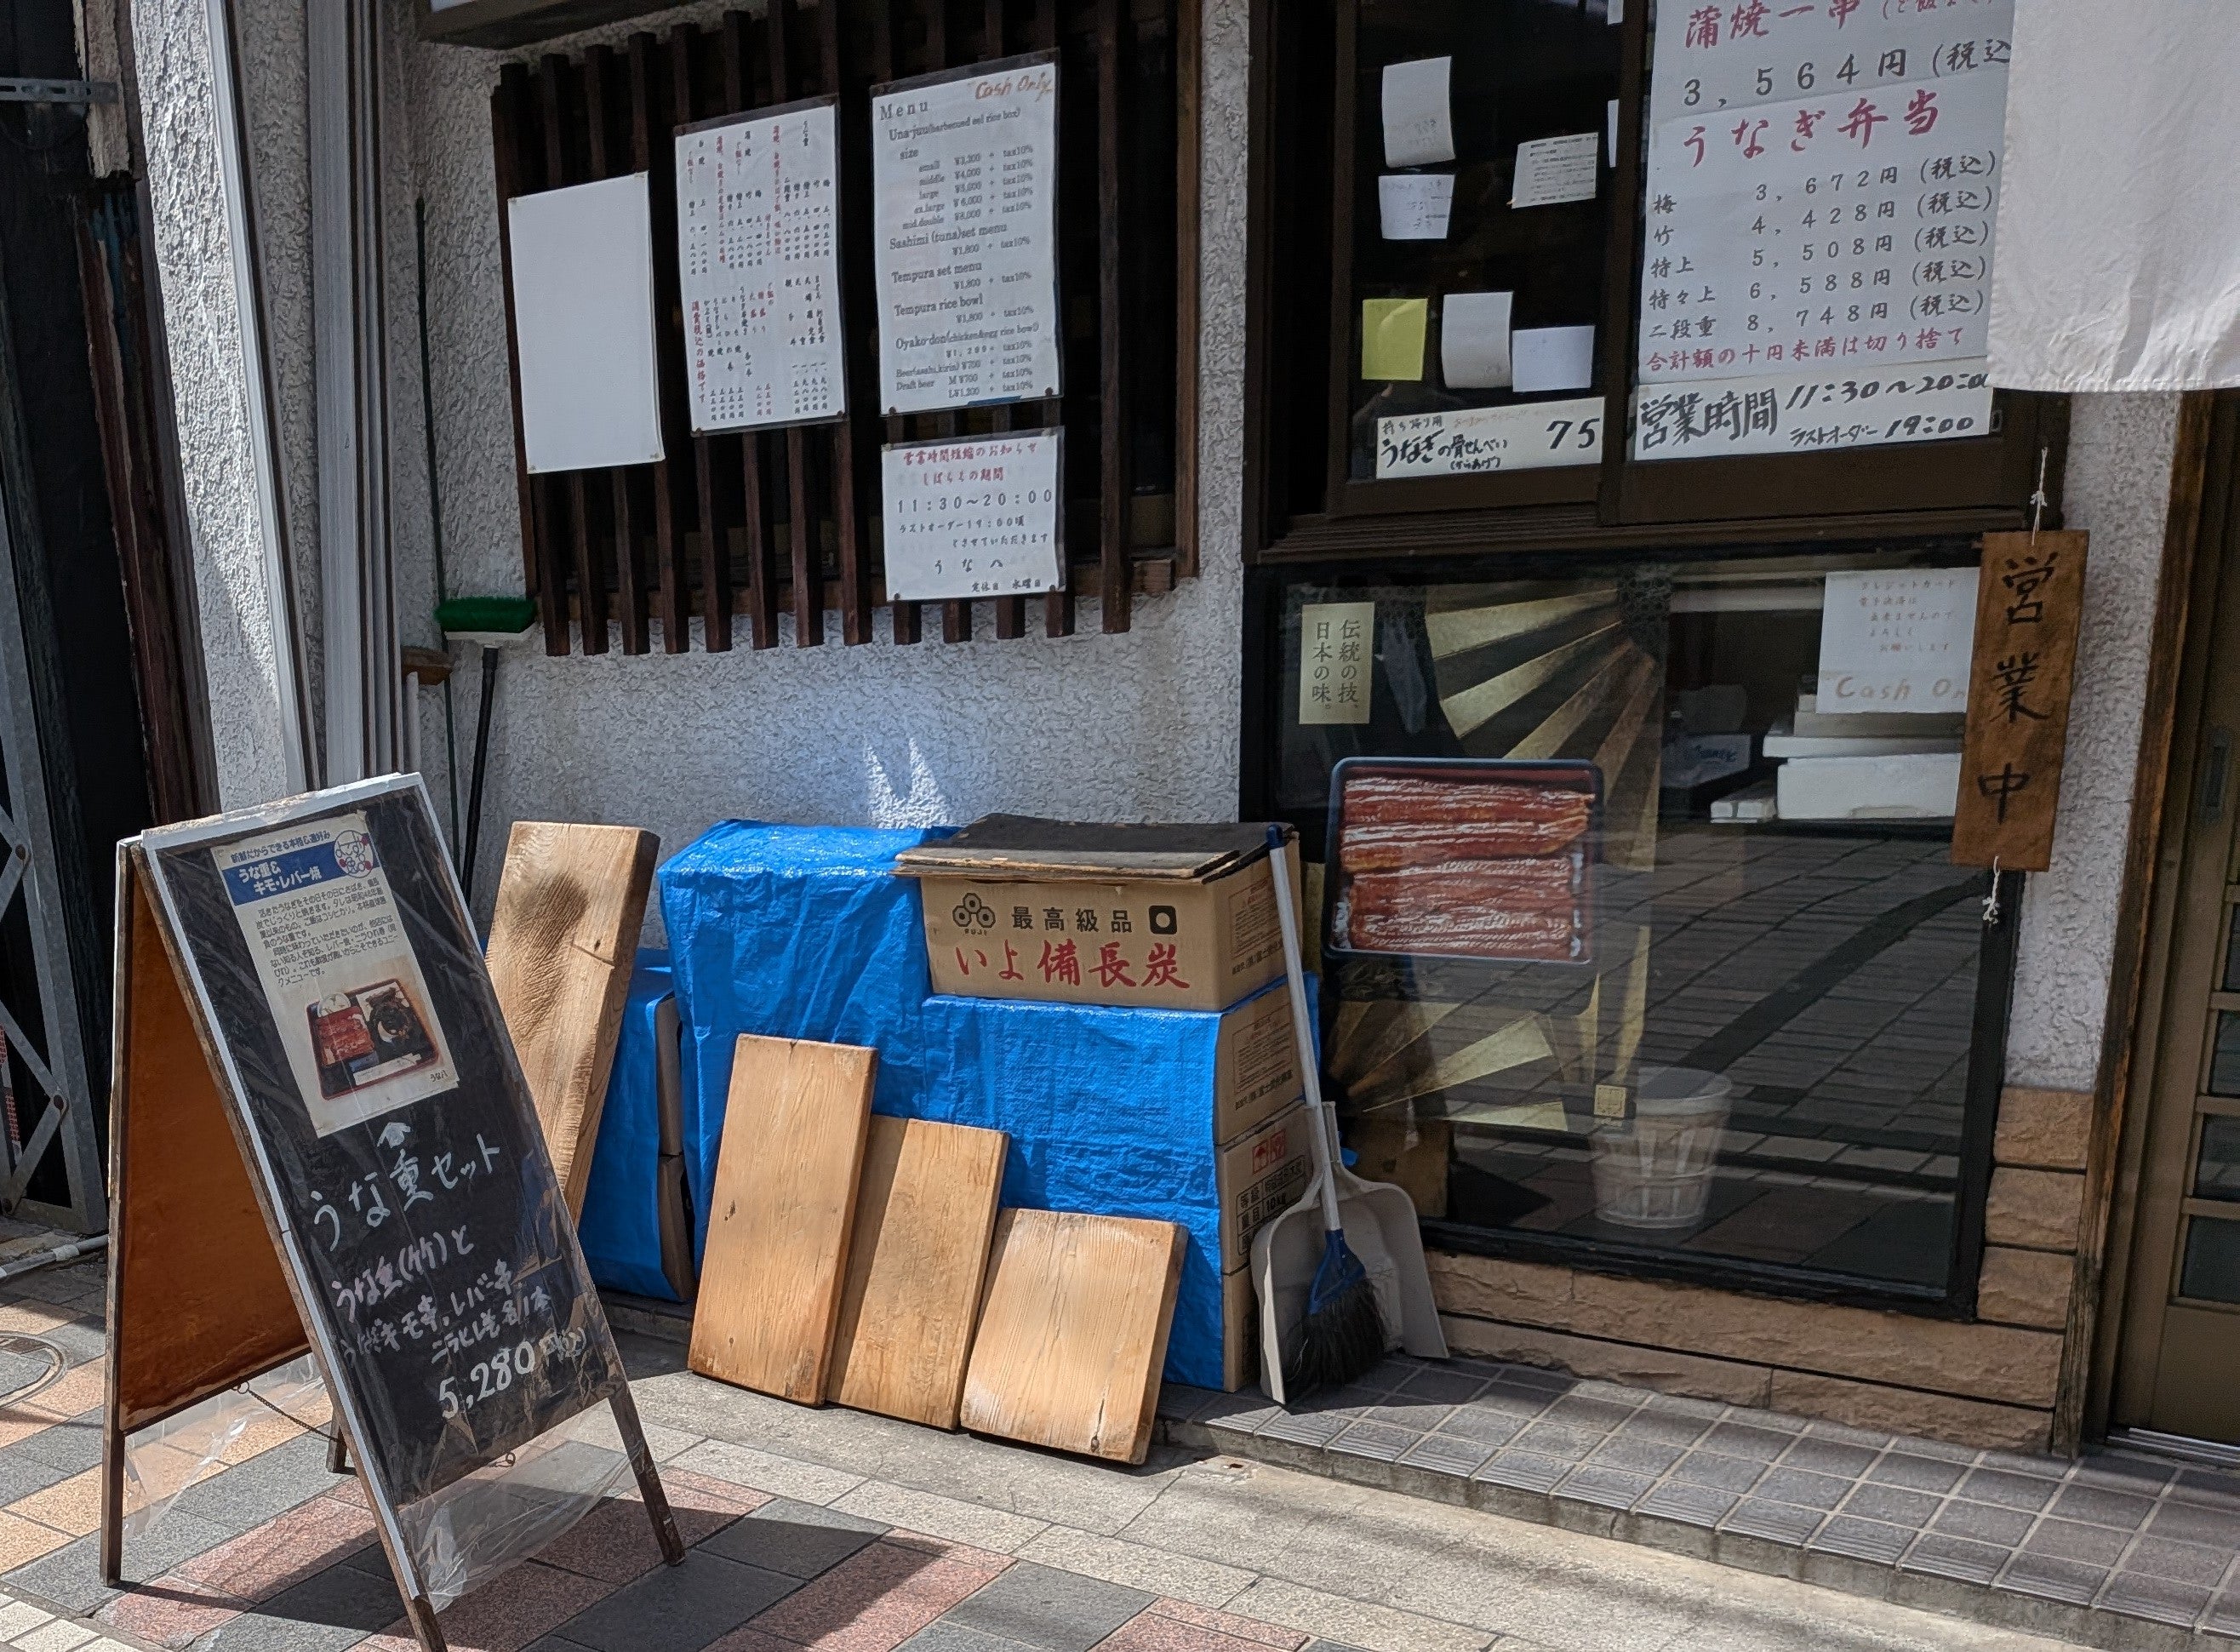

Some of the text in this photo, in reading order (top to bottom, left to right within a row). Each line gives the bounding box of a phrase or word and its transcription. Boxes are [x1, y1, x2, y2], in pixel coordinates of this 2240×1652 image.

[880, 101, 929, 120] Menu
[1684, 89, 1938, 167] うなぎ弁当
[900, 148, 918, 160] size
[1653, 194, 1677, 214] 梅
[1654, 225, 1674, 246] 竹
[891, 268, 934, 283] Tempura
[954, 263, 982, 273] menu
[1650, 257, 1694, 278] 特上
[894, 294, 984, 317] Tempura rice bowl
[1649, 284, 1716, 310] 特々上
[1649, 317, 1717, 339] 二段重
[1646, 328, 1964, 372] 合計額の十円未満は切り捨て
[1641, 388, 1777, 450] 営業時間
[1884, 414, 1974, 439] 19:00
[1836, 676, 1911, 700] Cash
[1977, 552, 2059, 825] 営業中
[1011, 906, 1133, 935] 最高級品
[955, 939, 1191, 989] いよ備長炭
[310, 1133, 500, 1252] うな重セット
